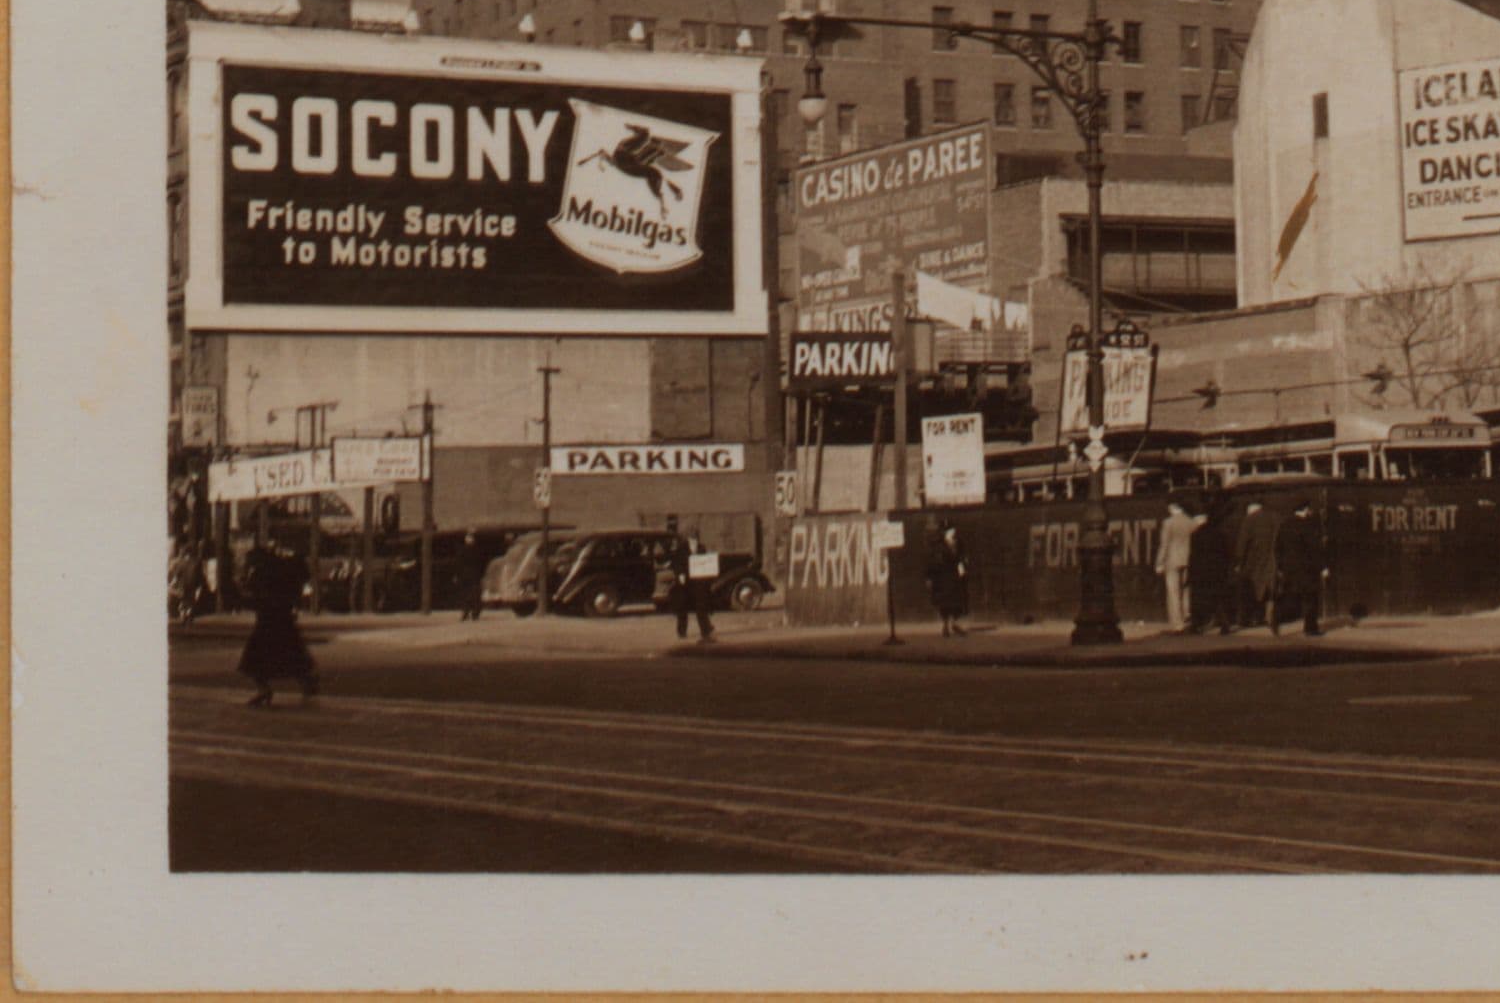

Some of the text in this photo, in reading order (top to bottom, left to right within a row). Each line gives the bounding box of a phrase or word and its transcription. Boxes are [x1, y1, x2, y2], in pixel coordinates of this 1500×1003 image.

[231, 93, 561, 184] SOCONY
[1404, 117, 1441, 149] ICE
[801, 158, 881, 209] CASINO
[883, 158, 904, 190] de
[907, 132, 985, 185] PAREE
[1406, 185, 1481, 210] ENTRANCE
[247, 200, 518, 238] Friendly Service
[566, 194, 688, 249] Mobilgas
[283, 236, 489, 269] to Motorists
[794, 342, 895, 376] PARKIN
[927, 417, 976, 436] FOR RENT
[567, 448, 733, 471] PARKING
[1369, 504, 1459, 533] FOR RENT
[1028, 518, 1159, 568] FOR ENT
